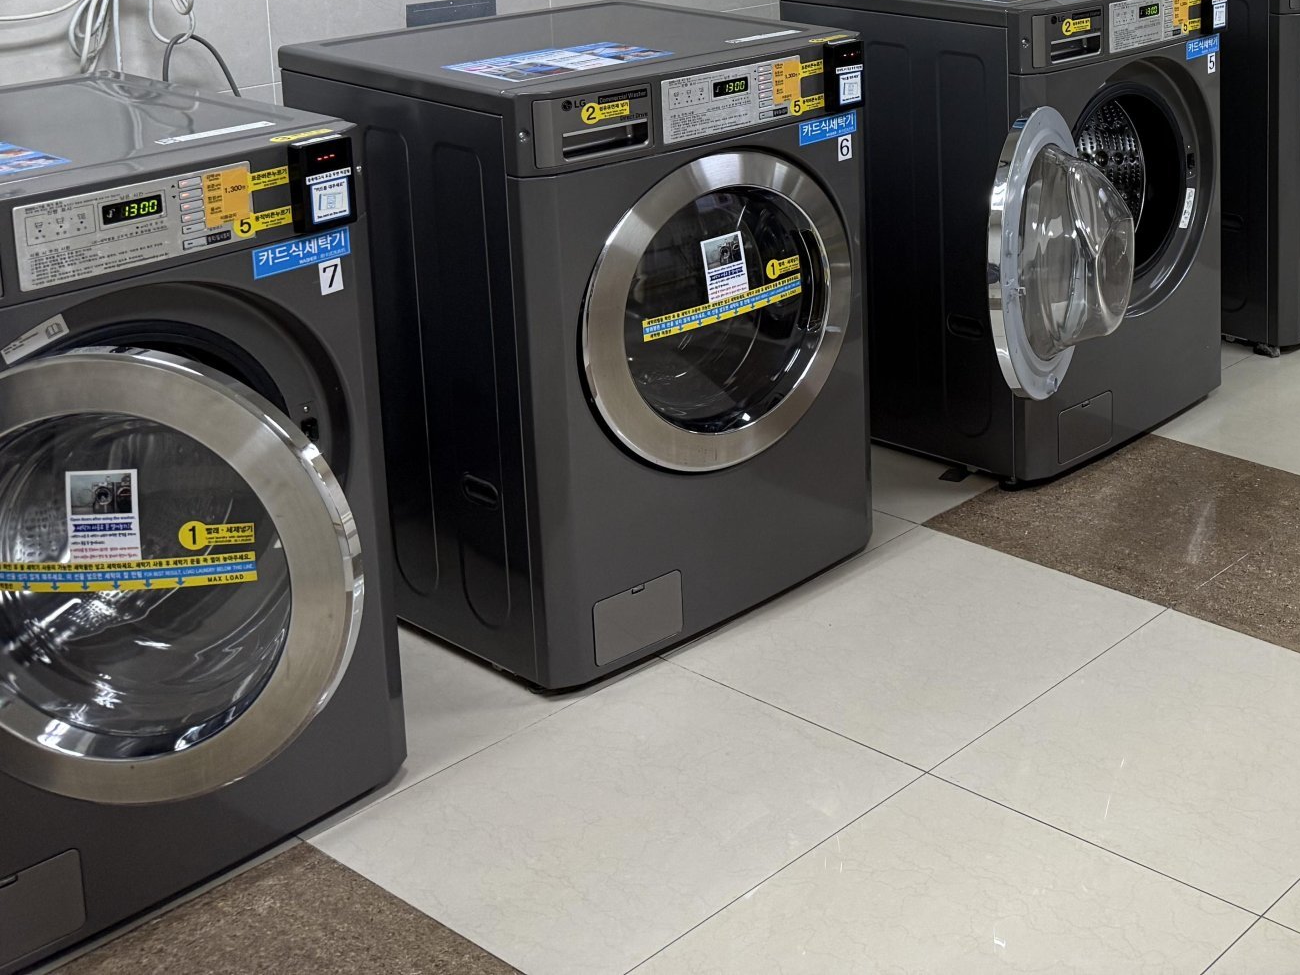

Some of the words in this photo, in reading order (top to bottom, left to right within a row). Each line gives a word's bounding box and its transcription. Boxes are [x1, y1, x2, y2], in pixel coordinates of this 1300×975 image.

[1065, 21, 1071, 32] 2
[1209, 55, 1214, 70] 5
[725, 81, 745, 92] 1300
[574, 100, 586, 108] LG
[794, 100, 801, 113] 5
[586, 106, 596, 120] 2
[803, 114, 854, 137] 카드식세탁기
[840, 138, 850, 156] 6
[251, 168, 287, 181] 표준버튼누르기
[124, 200, 157, 216] 1300
[255, 208, 290, 222] 동작버튼누르기
[240, 218, 252, 234] 5
[259, 231, 345, 265] 카드식세탁기
[322, 264, 338, 288] 7
[189, 526, 196, 545] 1
